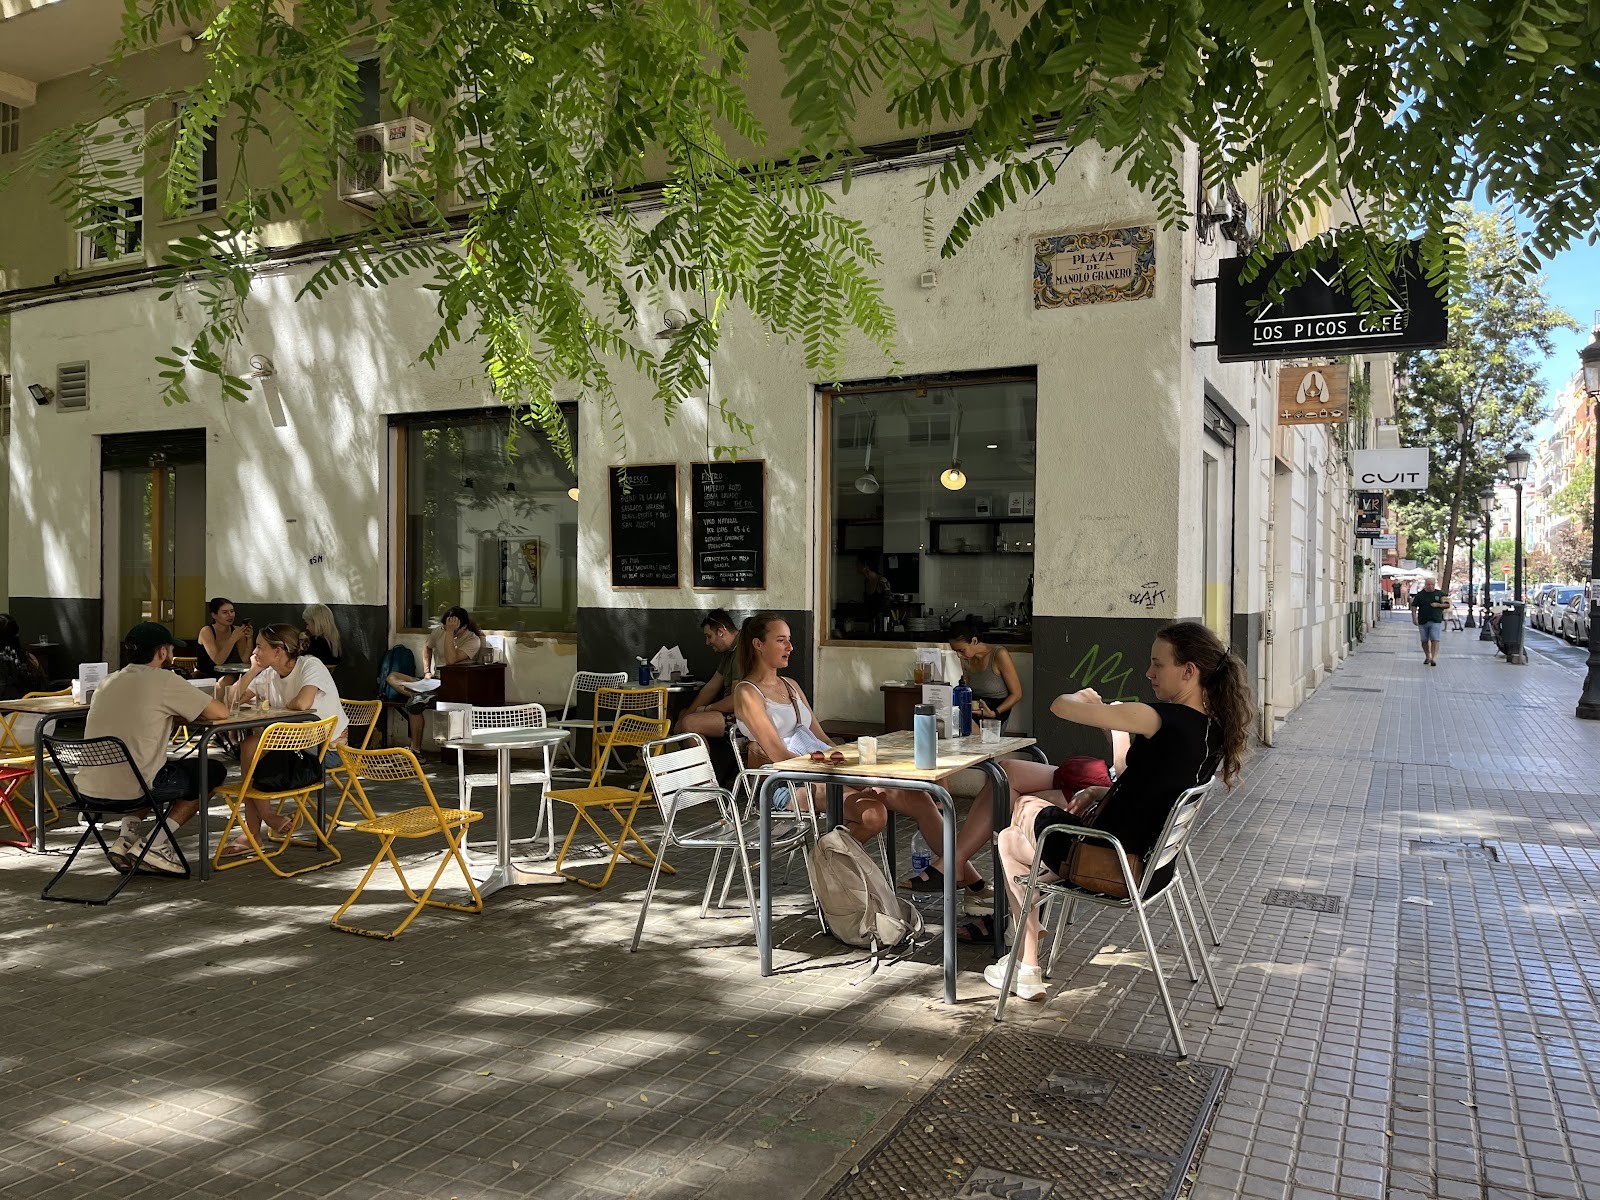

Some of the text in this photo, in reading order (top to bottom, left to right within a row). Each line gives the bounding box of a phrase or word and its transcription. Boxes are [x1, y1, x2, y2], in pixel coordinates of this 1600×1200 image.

[1072, 251, 1115, 265] PLAZA
[1055, 267, 1132, 285] MANOLO GRANERO
[1253, 325, 1283, 341] LOS
[1294, 320, 1347, 338] PICOS
[1361, 472, 1420, 484] CUIT
[1362, 498, 1380, 511] VR
